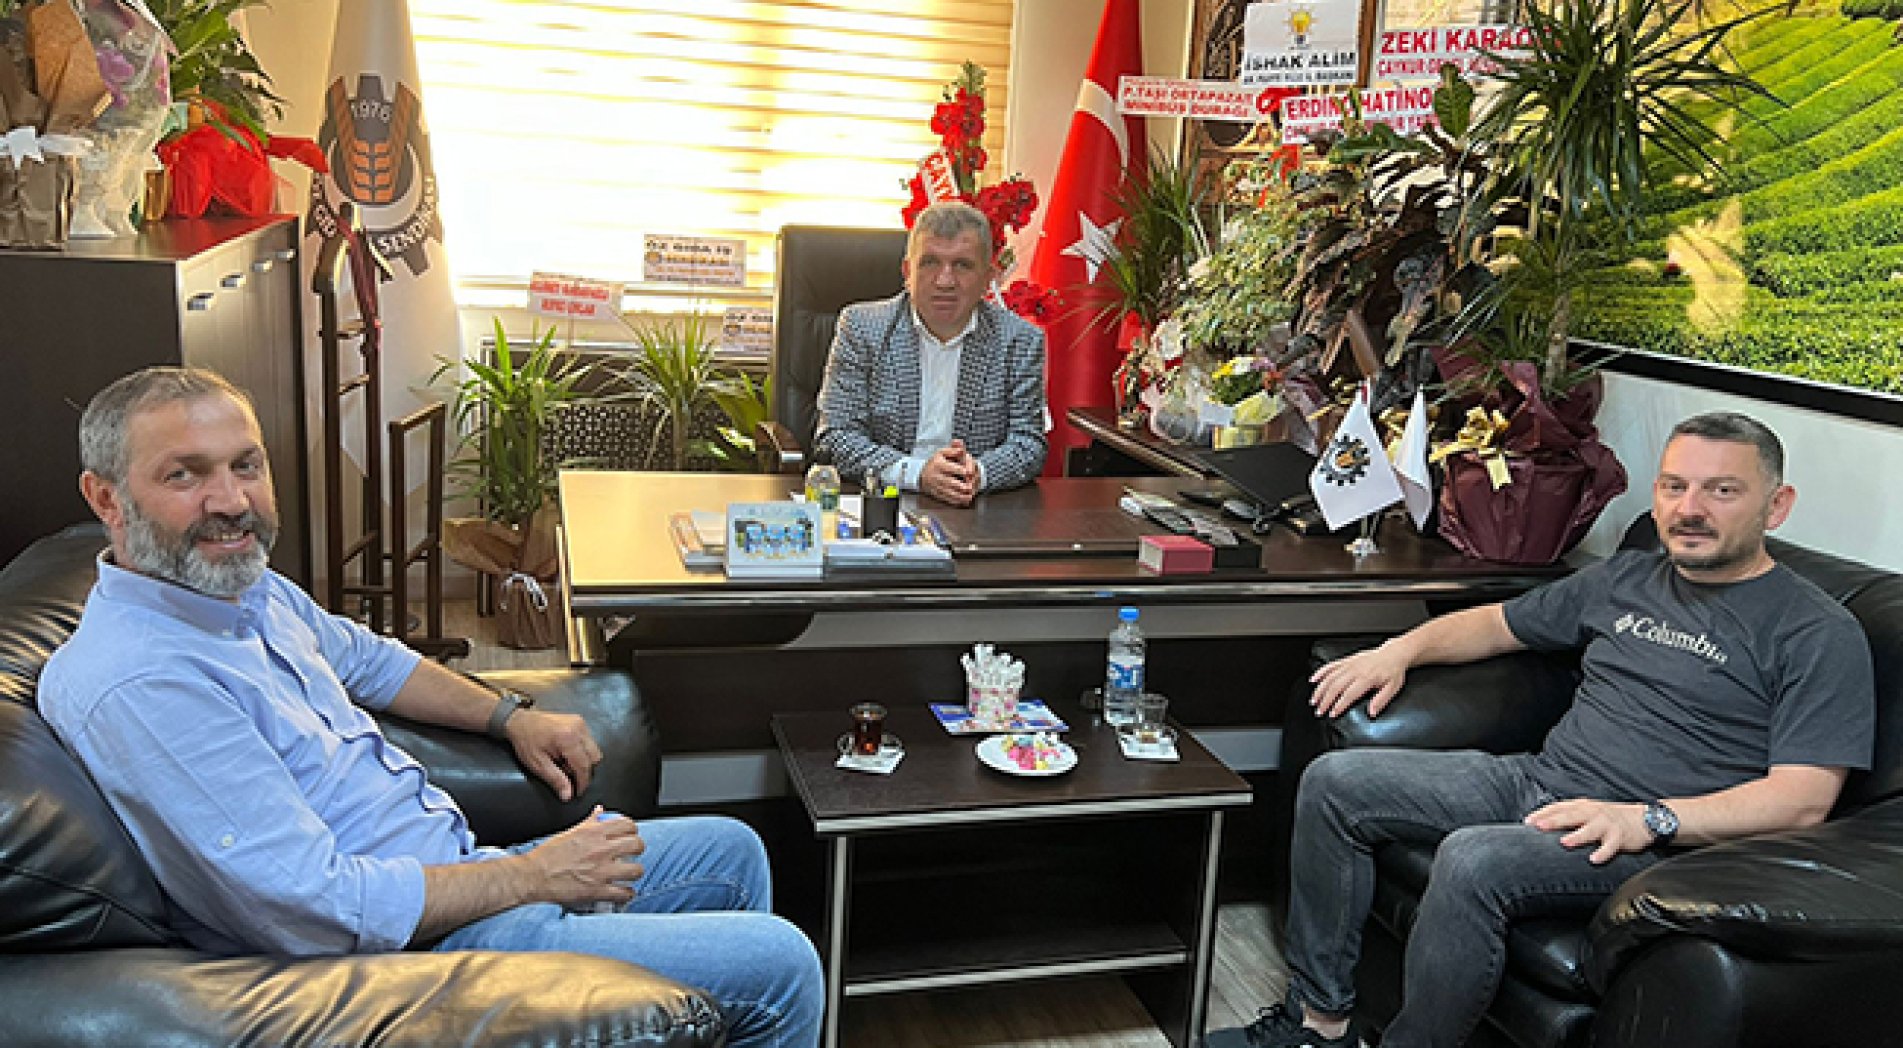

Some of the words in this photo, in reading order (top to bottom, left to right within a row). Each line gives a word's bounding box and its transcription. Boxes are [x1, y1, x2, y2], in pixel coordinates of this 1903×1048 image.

[1381, 26, 1438, 54] ZEKİ
[1244, 53, 1304, 71] İSHAK
[1308, 47, 1356, 68] ALİM
[351, 99, 392, 124] 1976
[1632, 616, 1728, 664] Columbia
